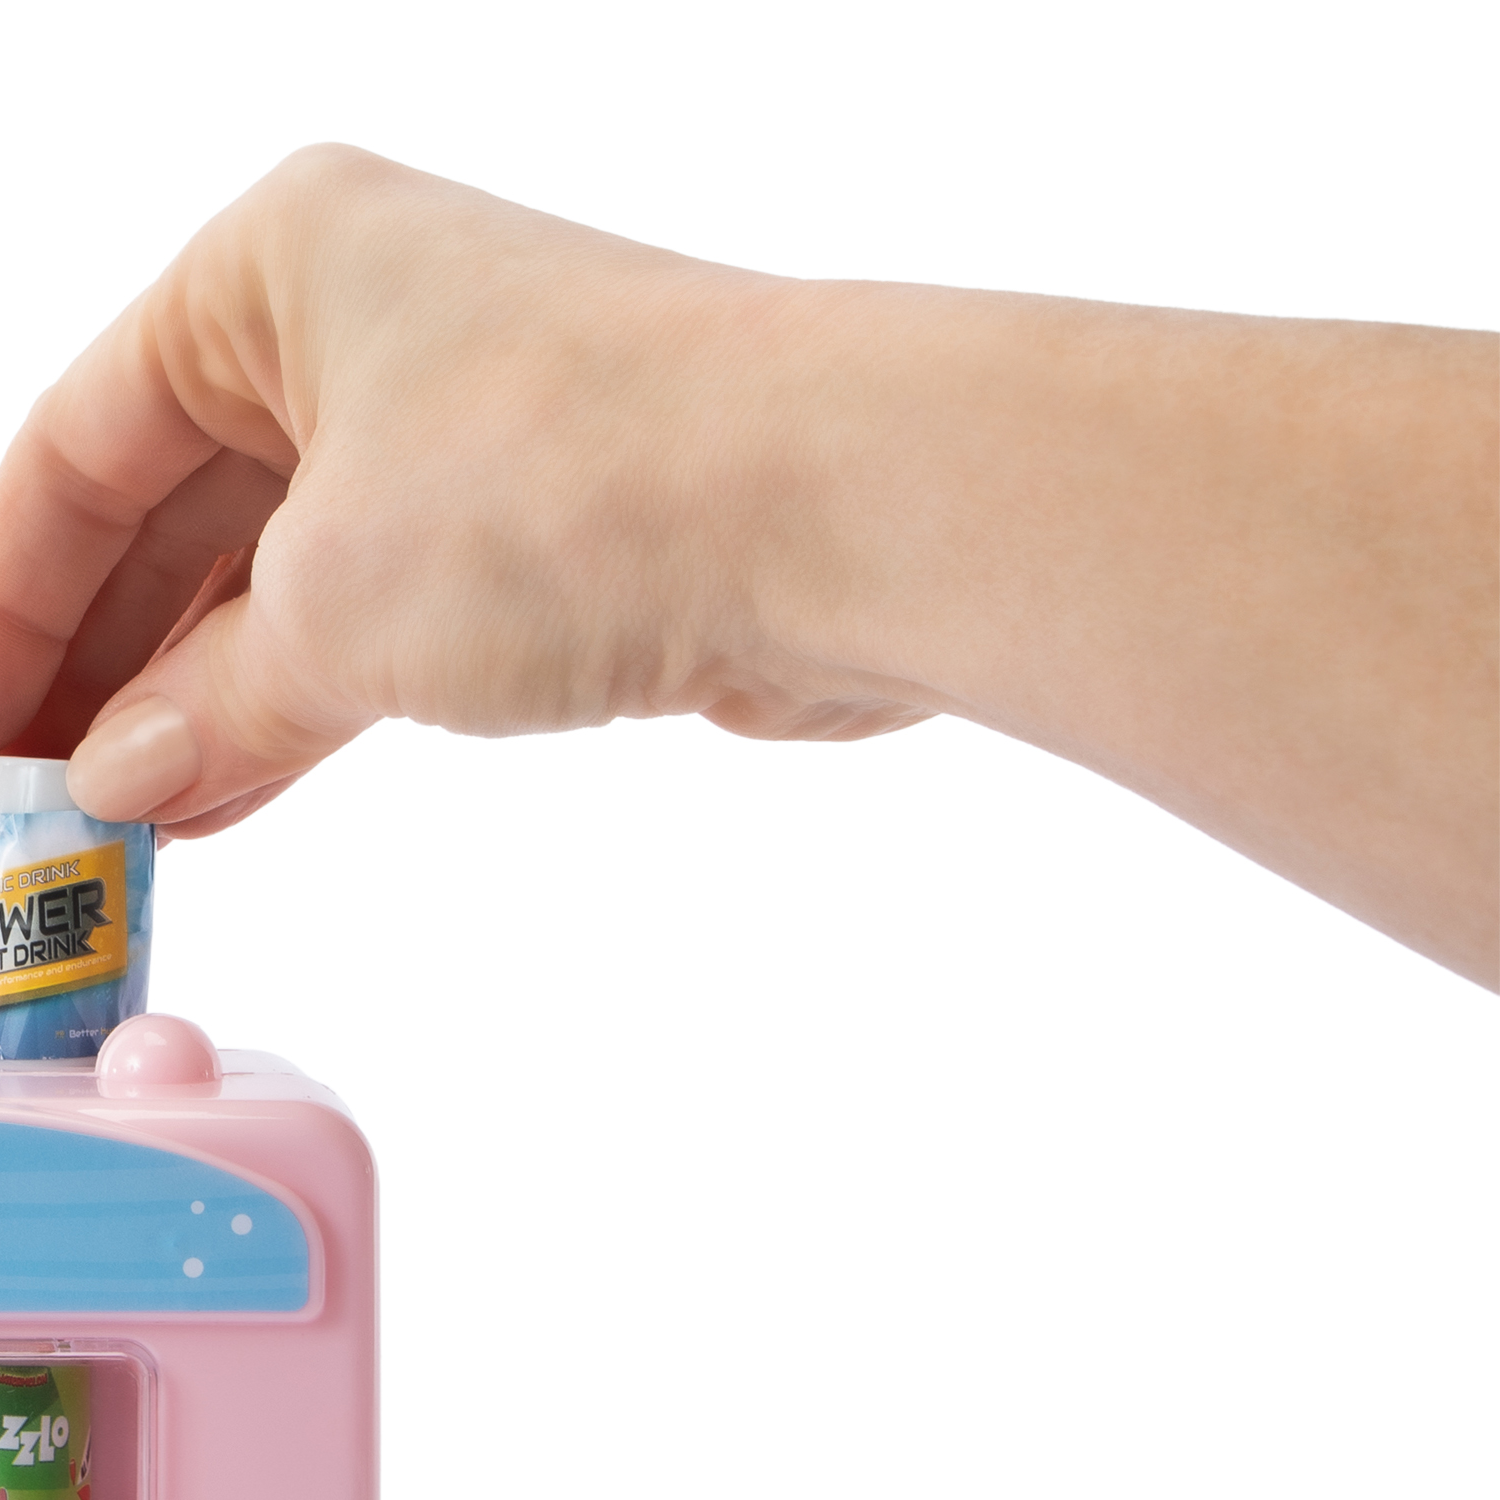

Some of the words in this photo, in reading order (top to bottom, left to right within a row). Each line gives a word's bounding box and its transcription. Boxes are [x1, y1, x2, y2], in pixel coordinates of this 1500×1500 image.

[18, 859, 81, 889] DRINK
[13, 930, 95, 967] DRINK
[46, 963, 64, 976] and
[65, 953, 112, 972] endurance
[68, 1028, 100, 1039] Better
